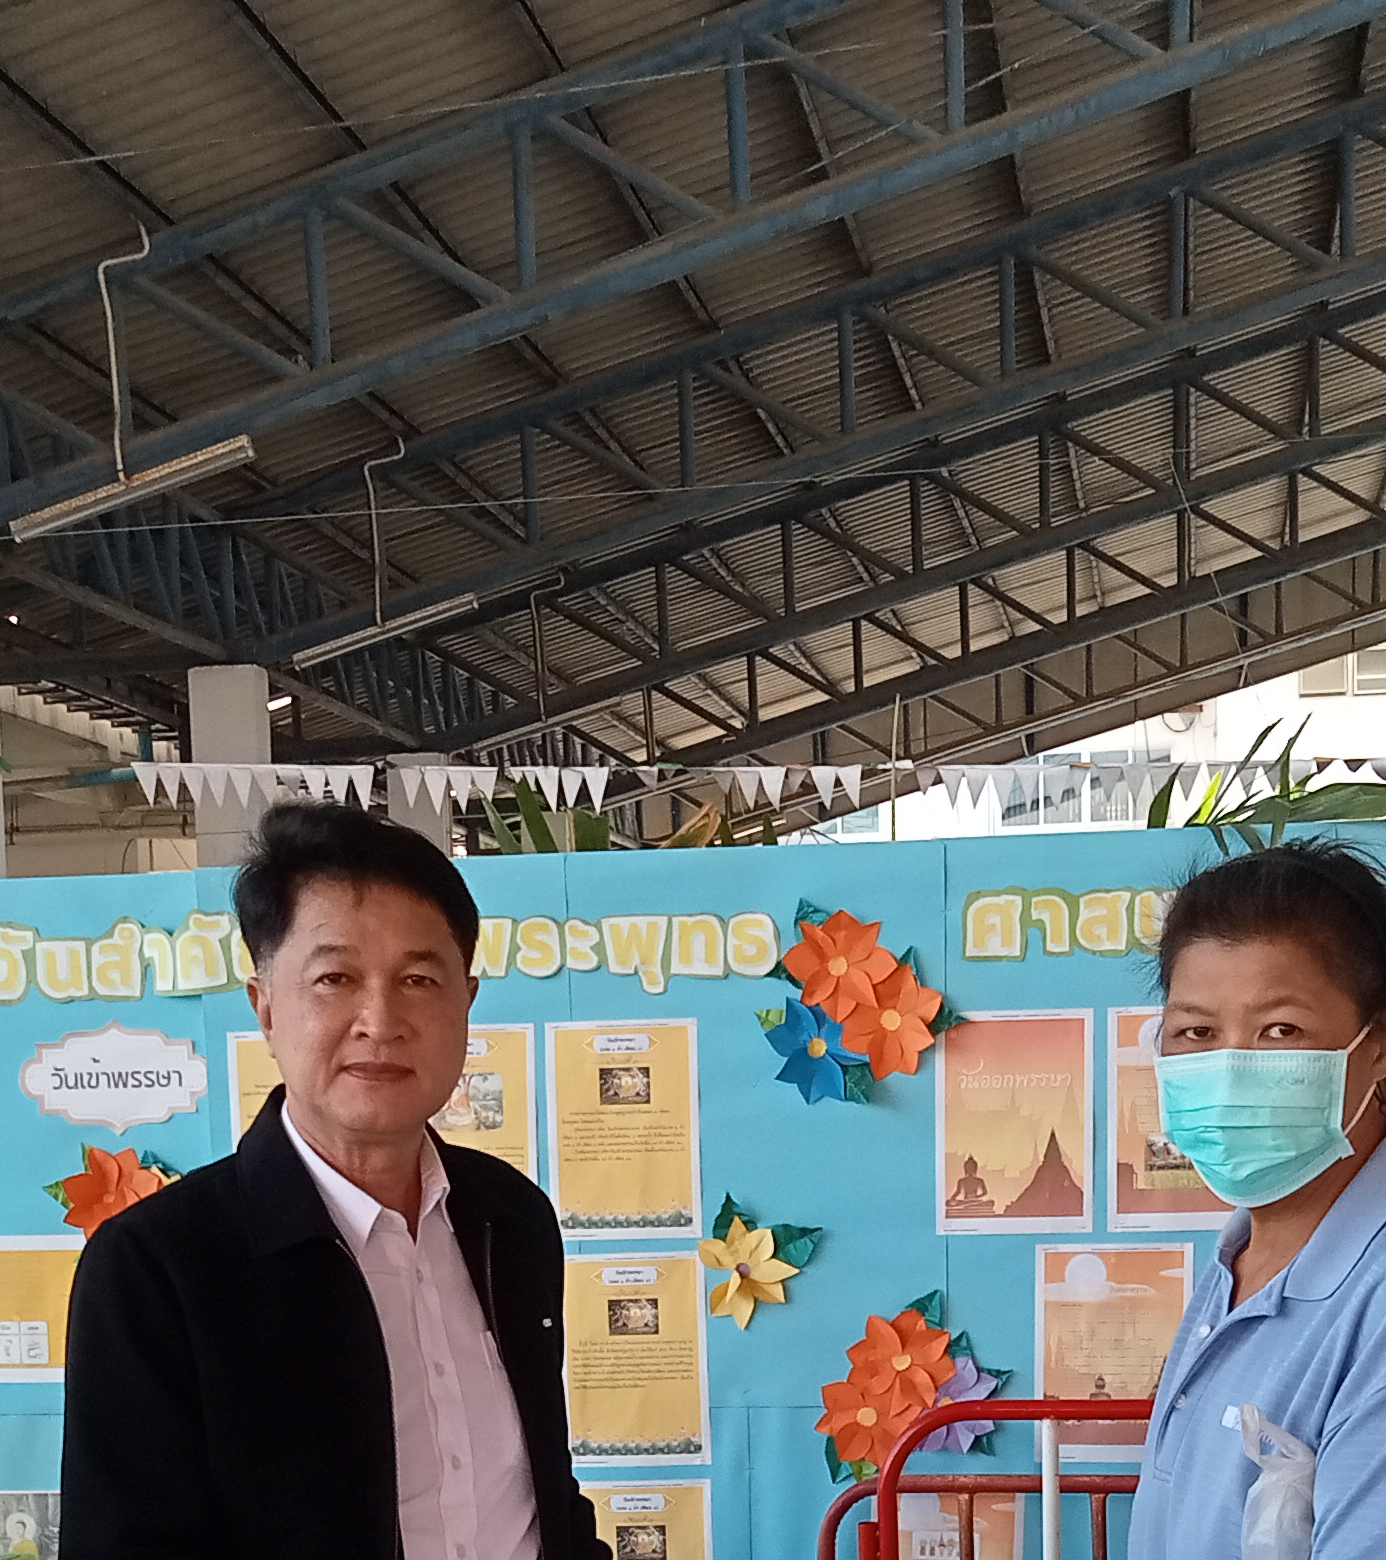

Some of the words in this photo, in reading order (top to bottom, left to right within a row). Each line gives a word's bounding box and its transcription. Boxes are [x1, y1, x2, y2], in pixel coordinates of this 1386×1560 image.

[51, 1056, 184, 1091] วันเข้าพรรษา
[957, 1066, 1072, 1091] วันออกพรรษา
